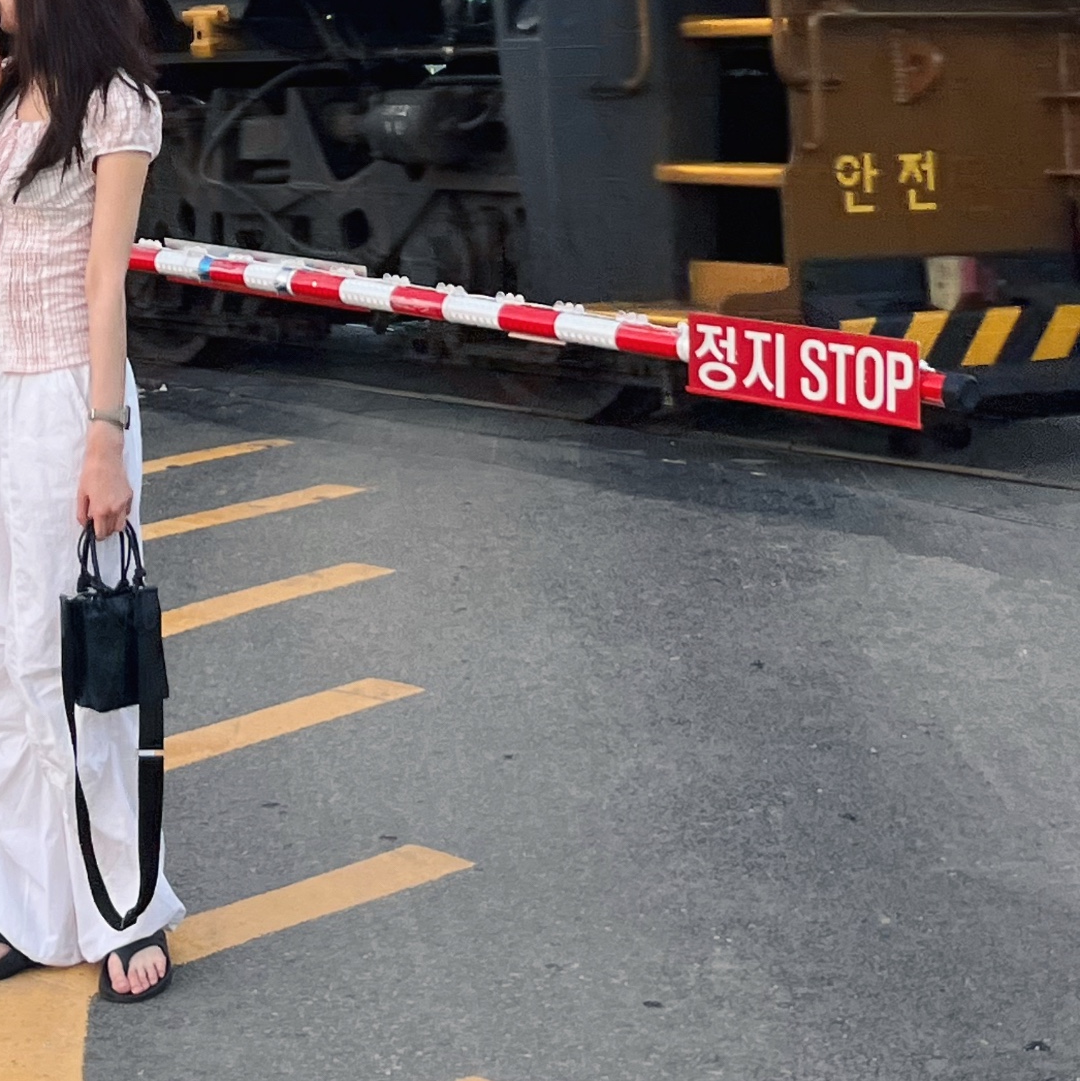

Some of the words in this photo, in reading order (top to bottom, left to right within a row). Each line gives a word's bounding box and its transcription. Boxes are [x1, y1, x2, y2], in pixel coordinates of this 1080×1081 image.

[835, 150, 938, 213] 안전
[694, 323, 786, 400] 정지
[799, 338, 914, 413] STOP
